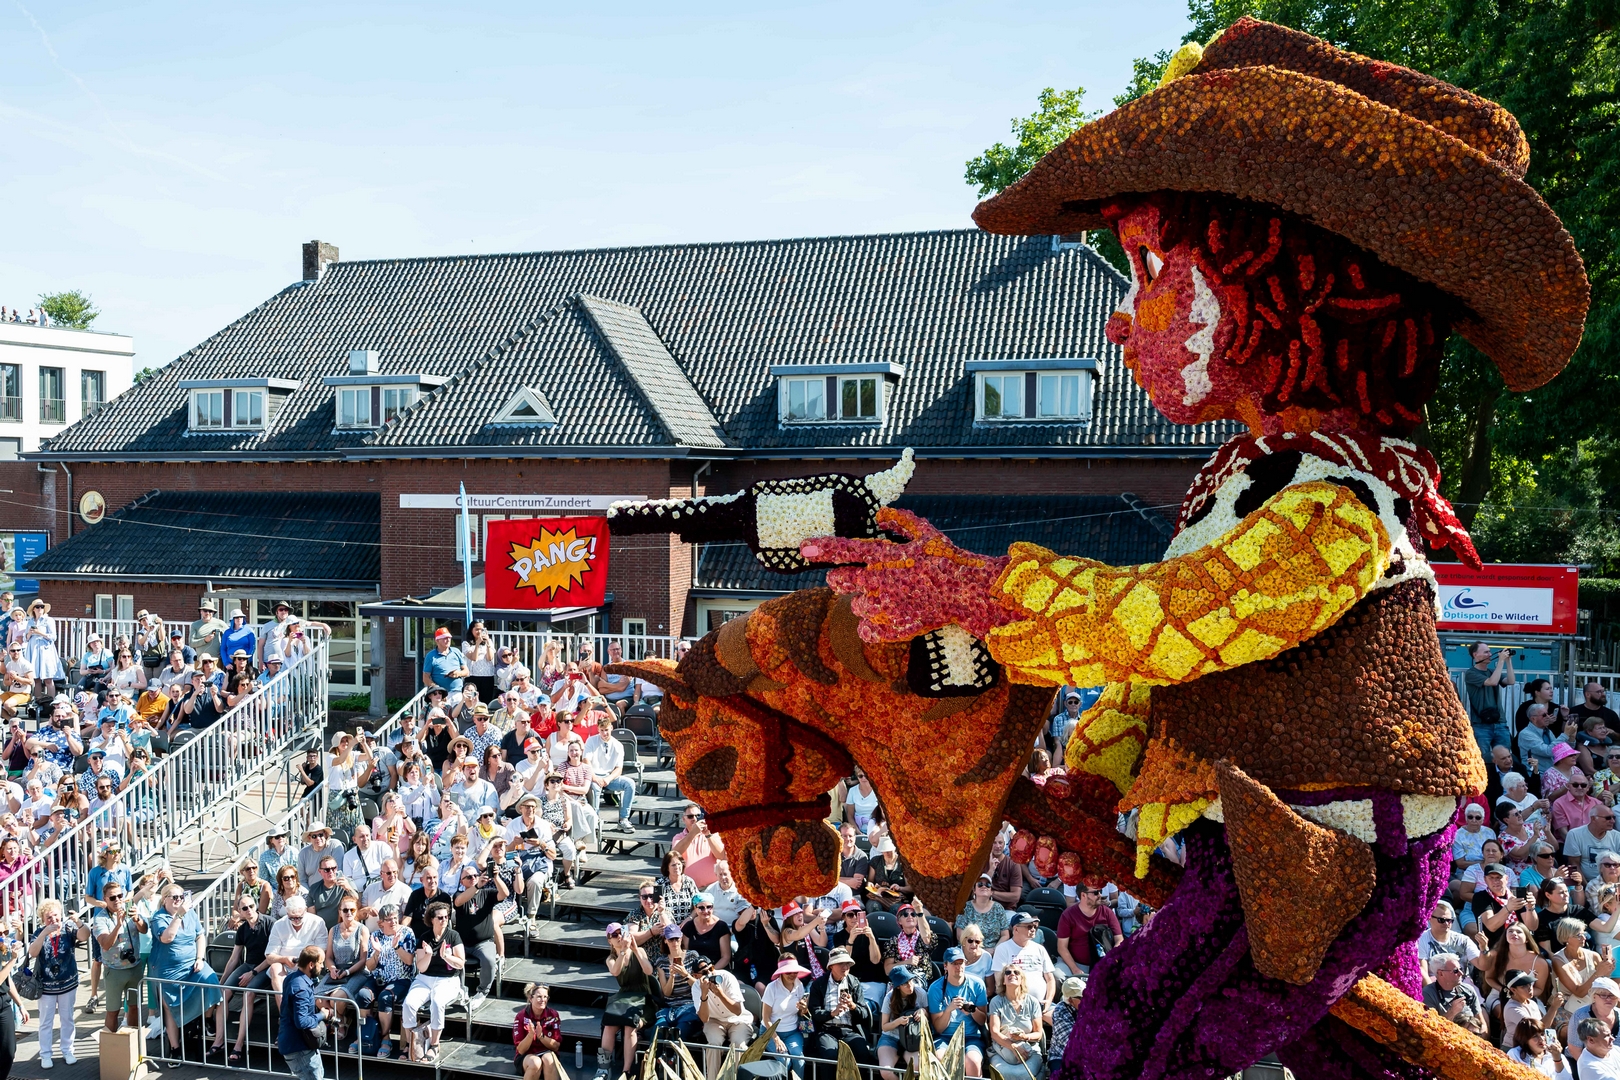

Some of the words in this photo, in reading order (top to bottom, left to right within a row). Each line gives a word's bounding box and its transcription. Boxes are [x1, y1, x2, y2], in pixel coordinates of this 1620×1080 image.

[512, 537, 597, 583] PANG!
[1497, 574, 1535, 582] gesponsord
[1443, 611, 1489, 620] Optisport
[1490, 612, 1503, 620] De
[1505, 613, 1539, 622] Wildert
